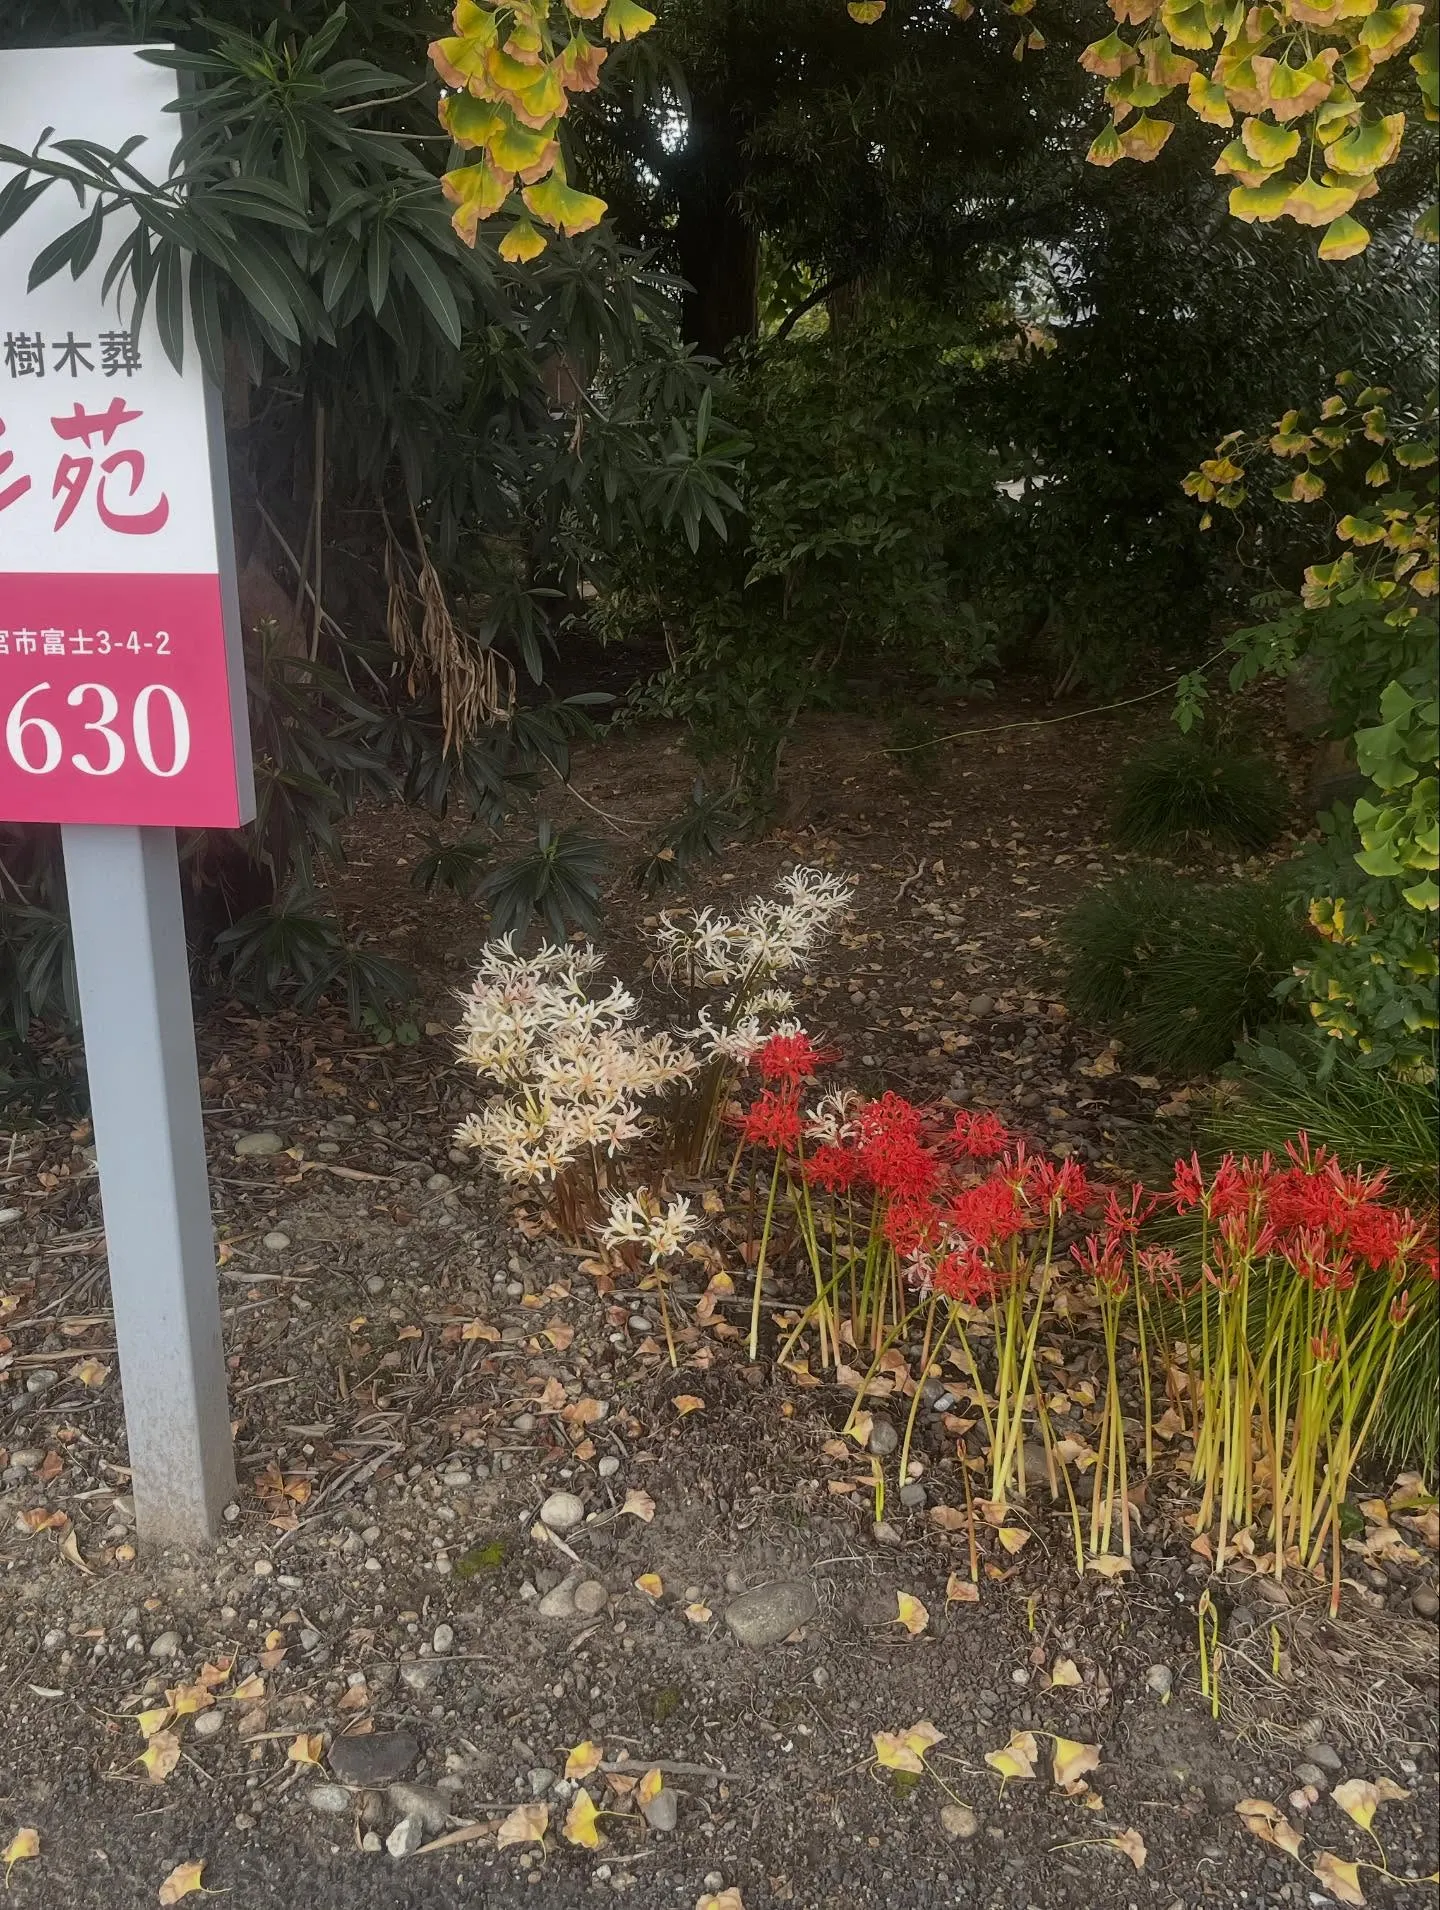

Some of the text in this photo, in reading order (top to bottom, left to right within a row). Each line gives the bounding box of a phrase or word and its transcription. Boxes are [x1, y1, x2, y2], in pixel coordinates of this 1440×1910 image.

[4, 331, 142, 378] 樹木葬
[6, 682, 190, 777] 630
